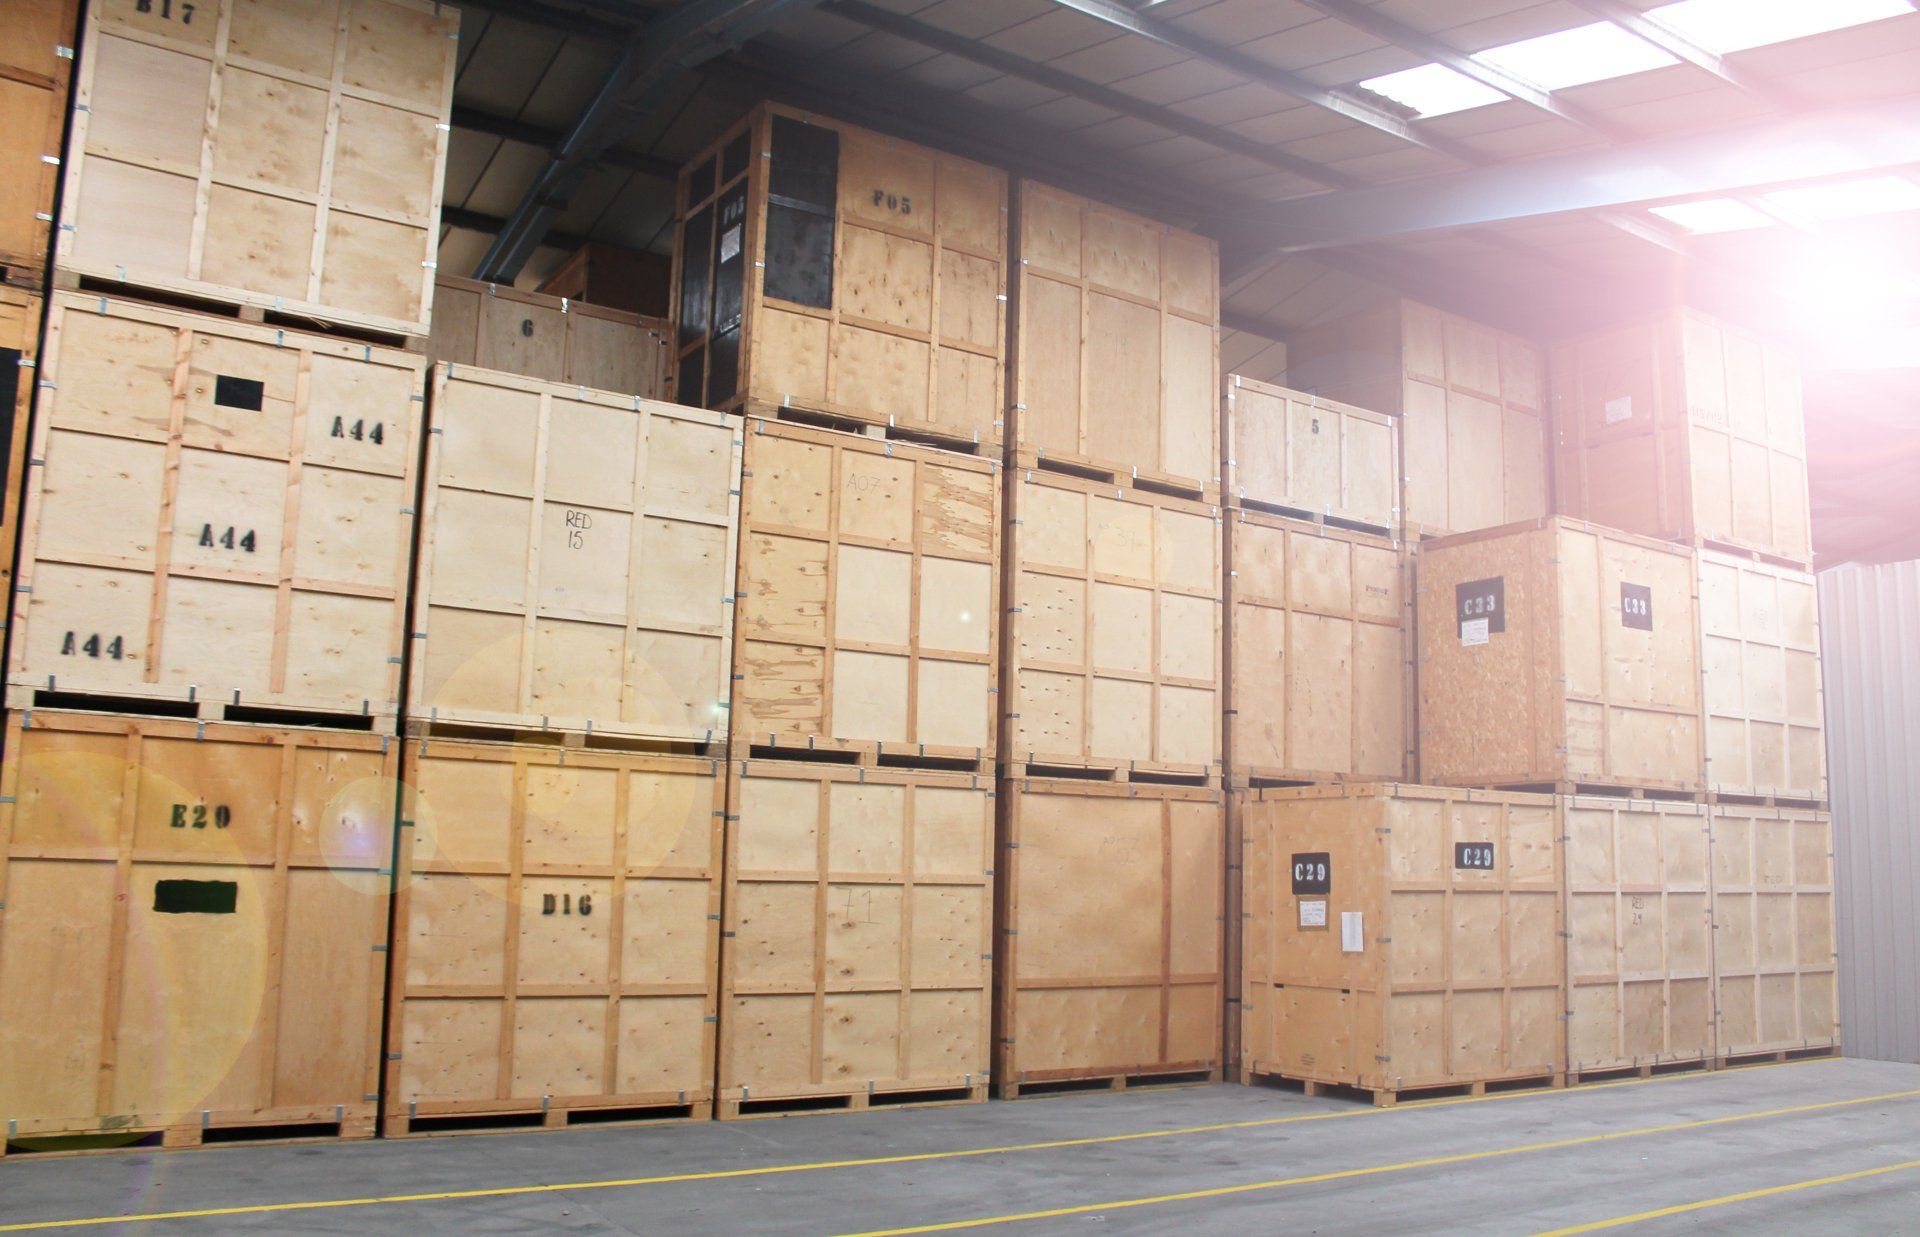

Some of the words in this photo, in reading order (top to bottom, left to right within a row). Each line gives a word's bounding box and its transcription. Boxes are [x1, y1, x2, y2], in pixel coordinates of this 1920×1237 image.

[723, 195, 744, 226] F05
[873, 189, 911, 215] F05
[522, 319, 533, 337] 6
[331, 415, 384, 446] A44
[1312, 418, 1320, 434] 5
[846, 473, 881, 495] A07
[565, 510, 593, 530] RED
[198, 523, 256, 553] A44
[568, 530, 584, 550] 15
[1463, 595, 1495, 616] C33
[1624, 597, 1647, 616] C33
[60, 631, 123, 660] A44
[170, 804, 231, 829] E20
[1463, 848, 1492, 867] C29
[1294, 863, 1326, 881] C29
[541, 893, 592, 916] D16
